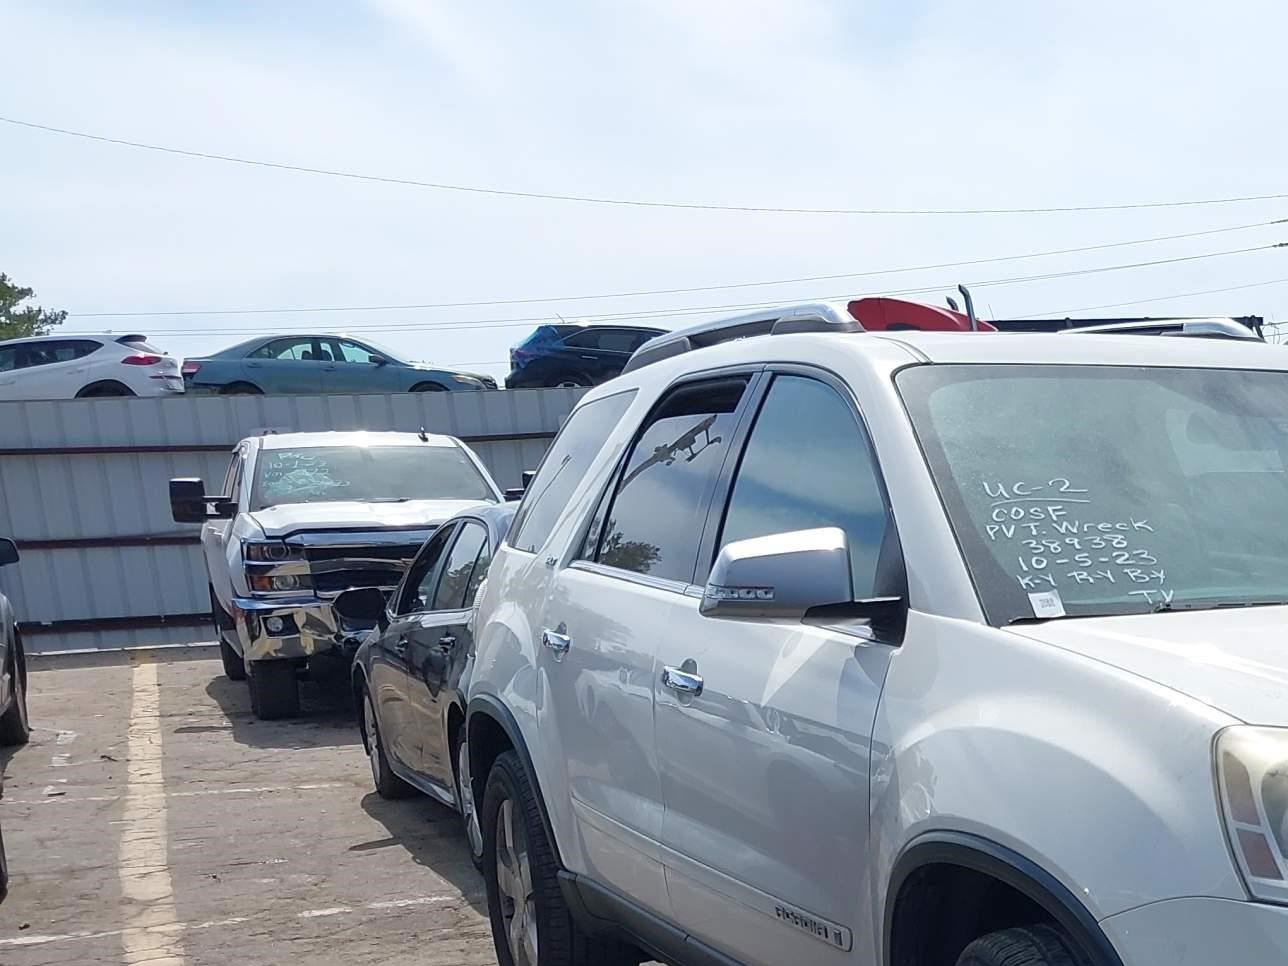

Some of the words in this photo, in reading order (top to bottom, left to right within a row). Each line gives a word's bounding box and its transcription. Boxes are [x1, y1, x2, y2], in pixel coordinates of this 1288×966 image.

[992, 505, 1068, 522] COSF
[1053, 517, 1154, 534] Wreck
[1021, 534, 1128, 554] 38938
[1018, 549, 1158, 572] 10-5-23
